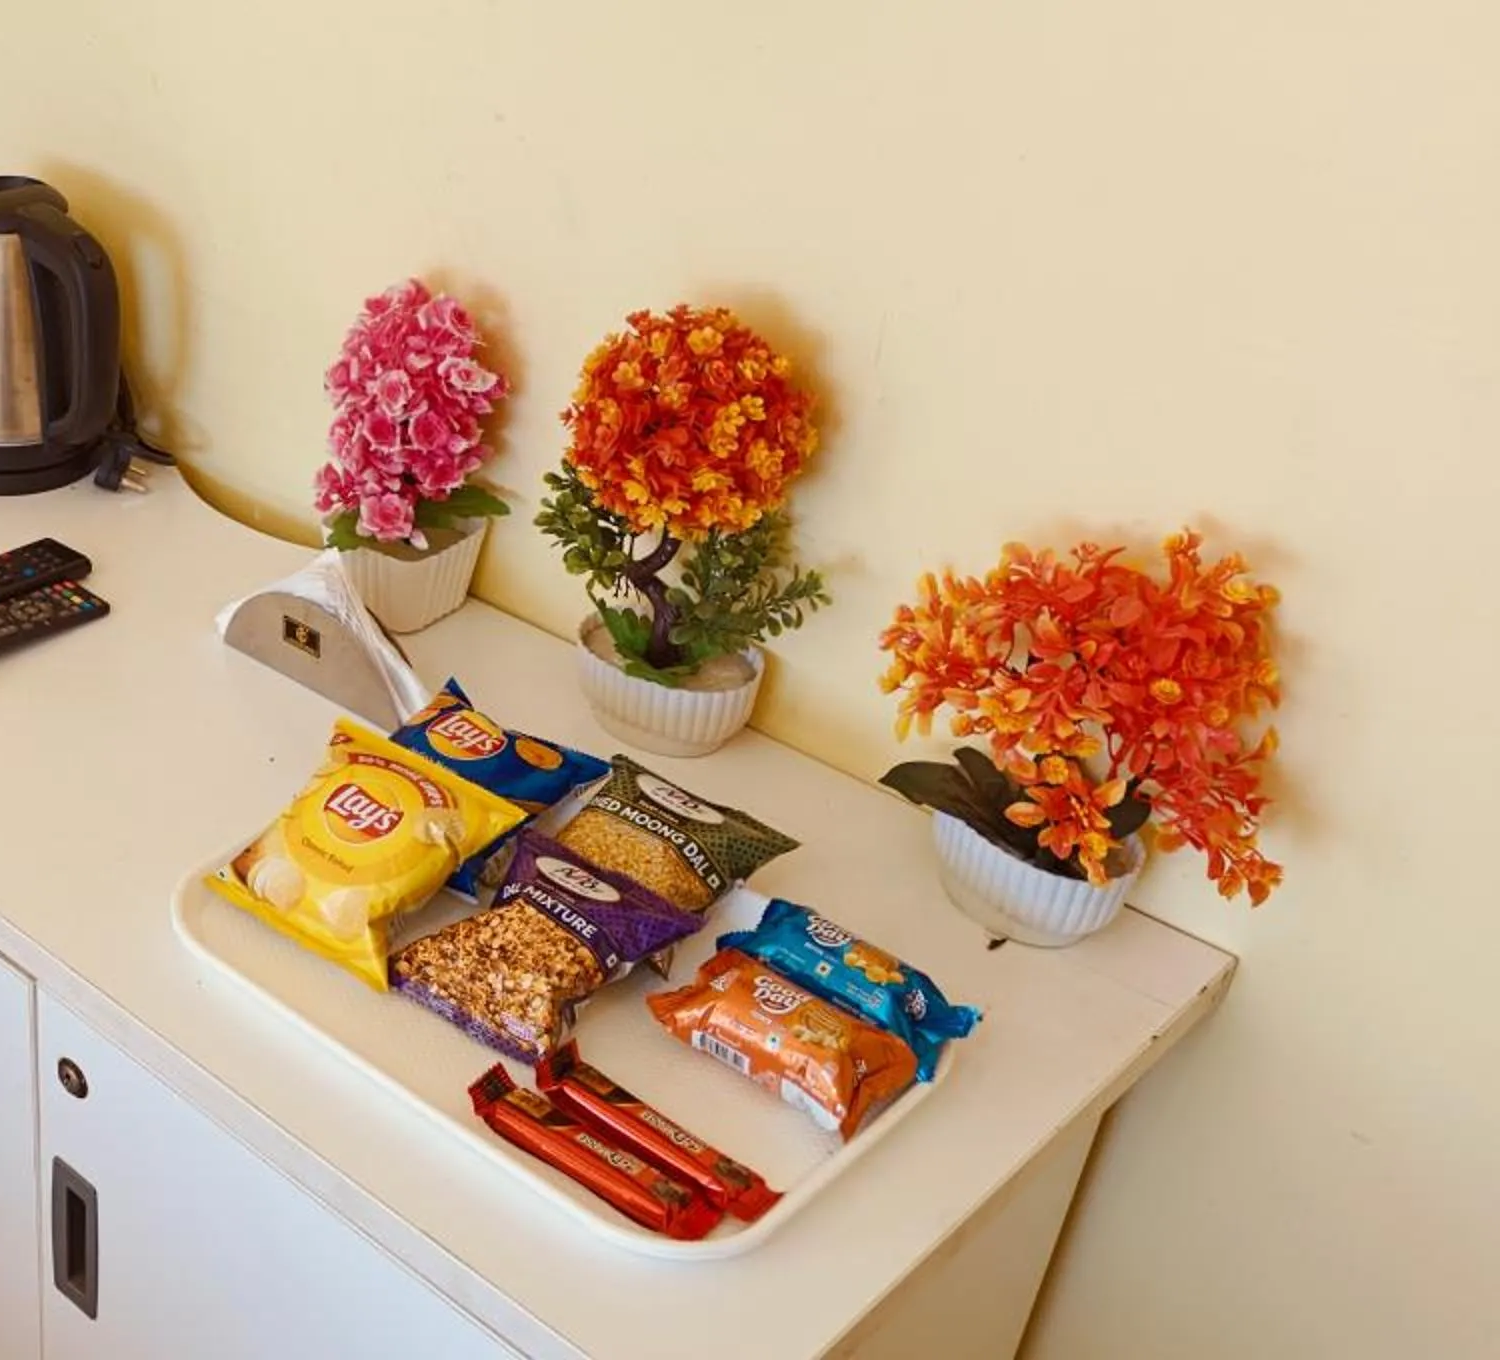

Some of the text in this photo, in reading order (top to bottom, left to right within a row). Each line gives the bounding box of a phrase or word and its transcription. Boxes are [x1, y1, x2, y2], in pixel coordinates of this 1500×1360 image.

[431, 714, 501, 751] Lay's
[328, 785, 400, 830] Lay's
[620, 807, 687, 845] MOONG
[683, 841, 710, 877] DAL
[522, 885, 598, 939] MIXTURE
[752, 987, 801, 1010] Day
[753, 975, 812, 1003] Good
